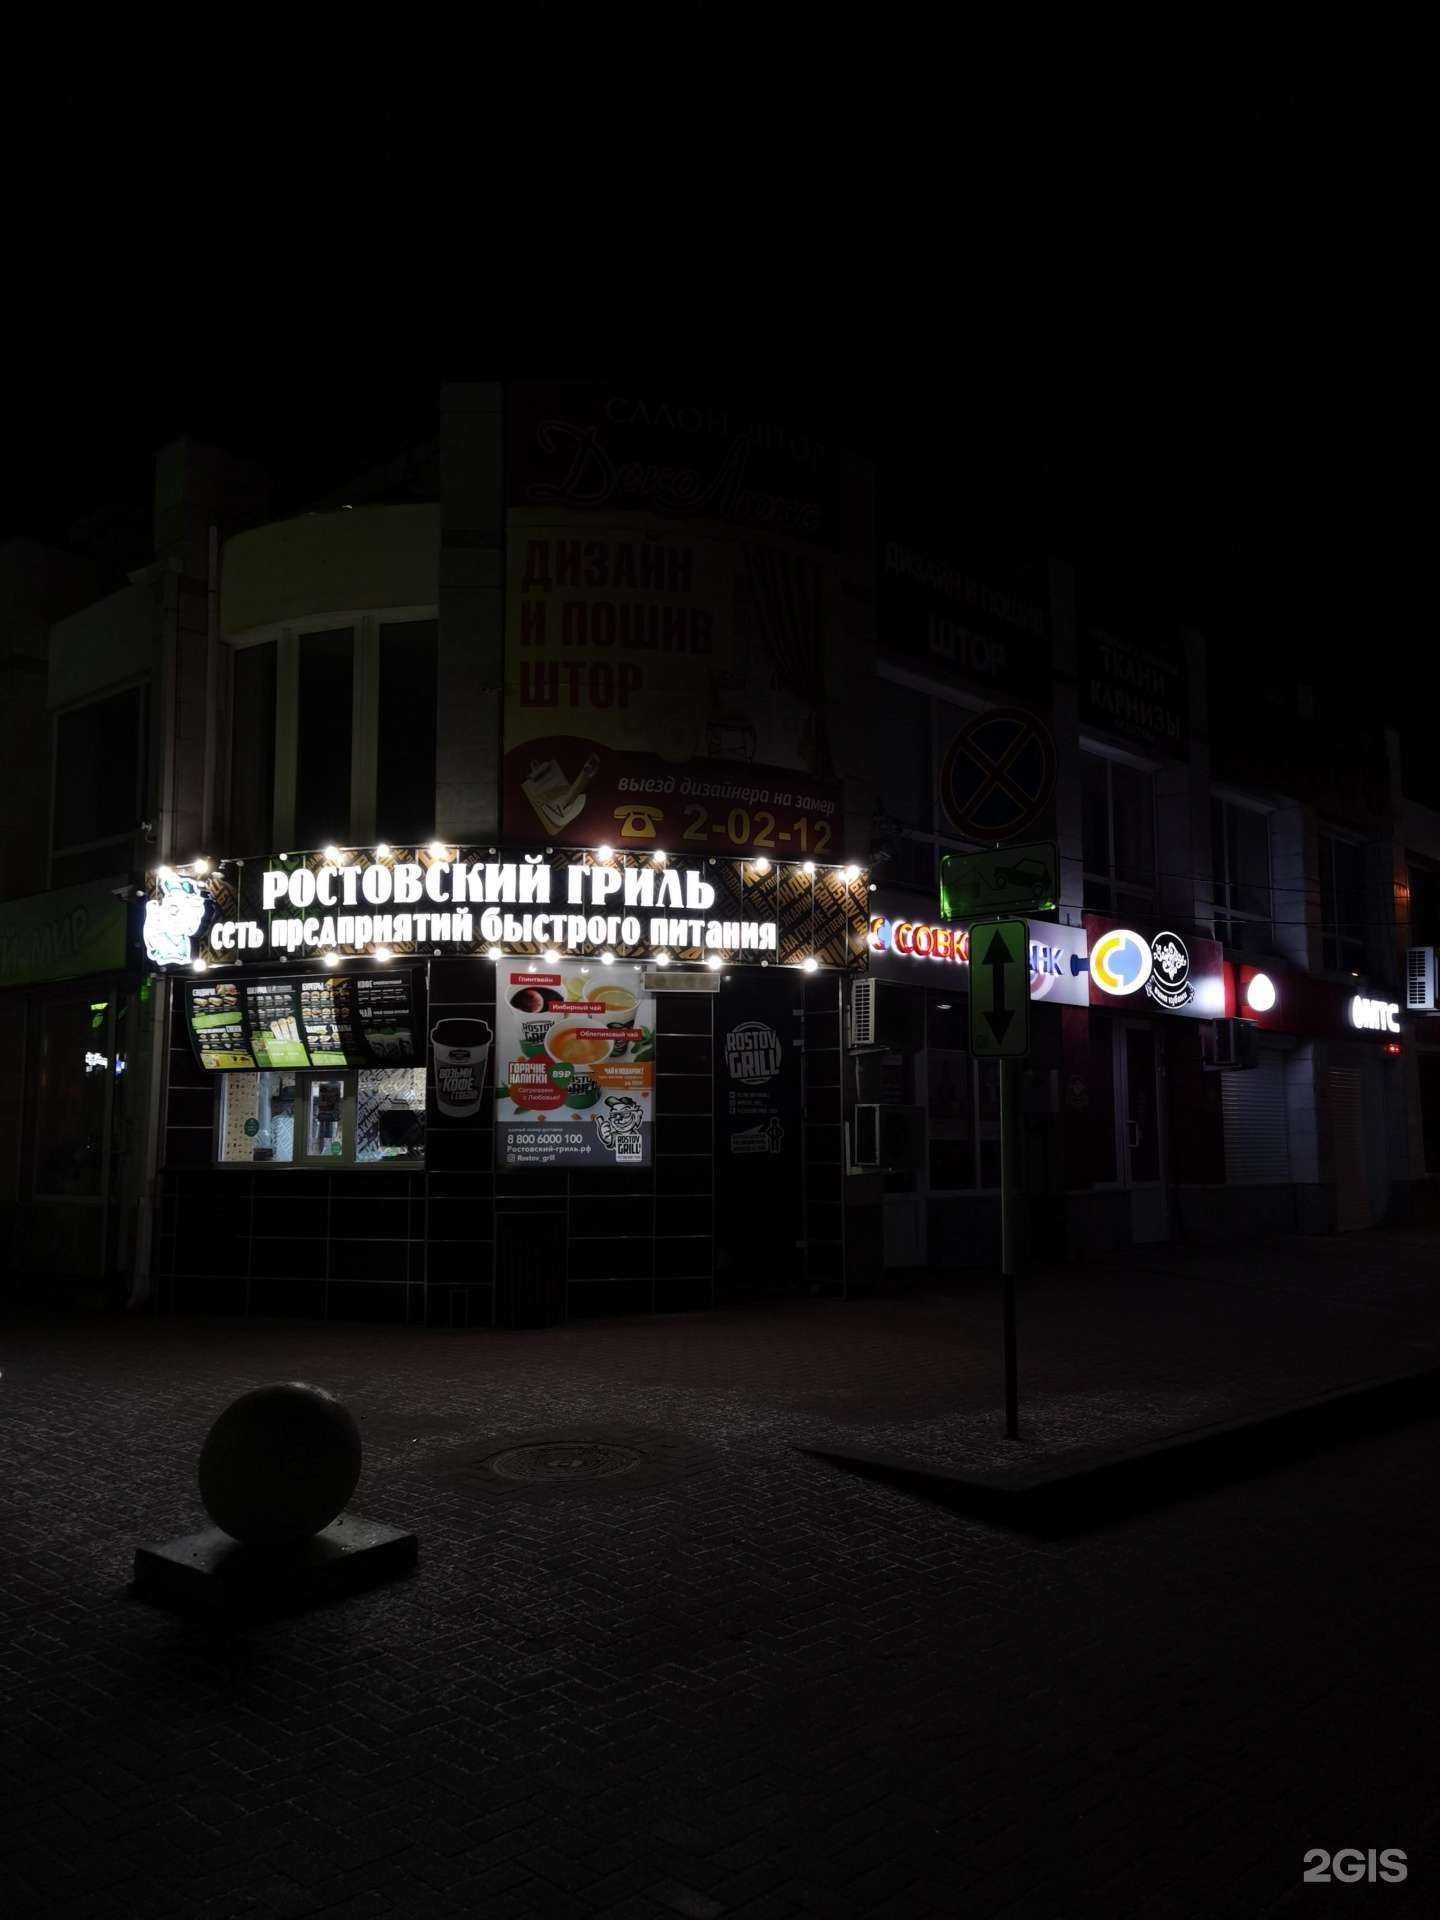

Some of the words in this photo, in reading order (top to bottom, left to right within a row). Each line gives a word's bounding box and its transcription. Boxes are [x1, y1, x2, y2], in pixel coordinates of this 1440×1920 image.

[521, 532, 694, 593] ДИЗАЙН
[520, 601, 546, 648] И
[562, 601, 715, 654] ПОШИВ
[519, 660, 642, 708] ШТОР
[618, 776, 676, 794] выезд
[679, 777, 769, 806] дизайнера
[773, 791, 792, 808] на
[795, 794, 836, 816] замер
[682, 803, 834, 855] 2-02-12
[262, 854, 551, 911] РОСТОВСКИЙ
[567, 863, 716, 911] ГРИЛЬ
[210, 920, 265, 951] сеть
[271, 906, 474, 952] предприятий
[479, 907, 642, 949] быстрого
[649, 918, 778, 951] питания
[551, 1003, 588, 1013] Имбирный
[589, 1003, 603, 1012] чай
[726, 1030, 776, 1052] ROSTOV
[508, 1061, 547, 1073] ГОРЯЧИЕ
[508, 1073, 548, 1085] НАПИТКИ
[728, 1050, 780, 1079] GRILL
[507, 1134, 514, 1144] 8
[516, 1134, 536, 1144] 800
[537, 1134, 562, 1144] 6000
[564, 1134, 583, 1144] 100
[618, 1143, 641, 1155] GRILL
